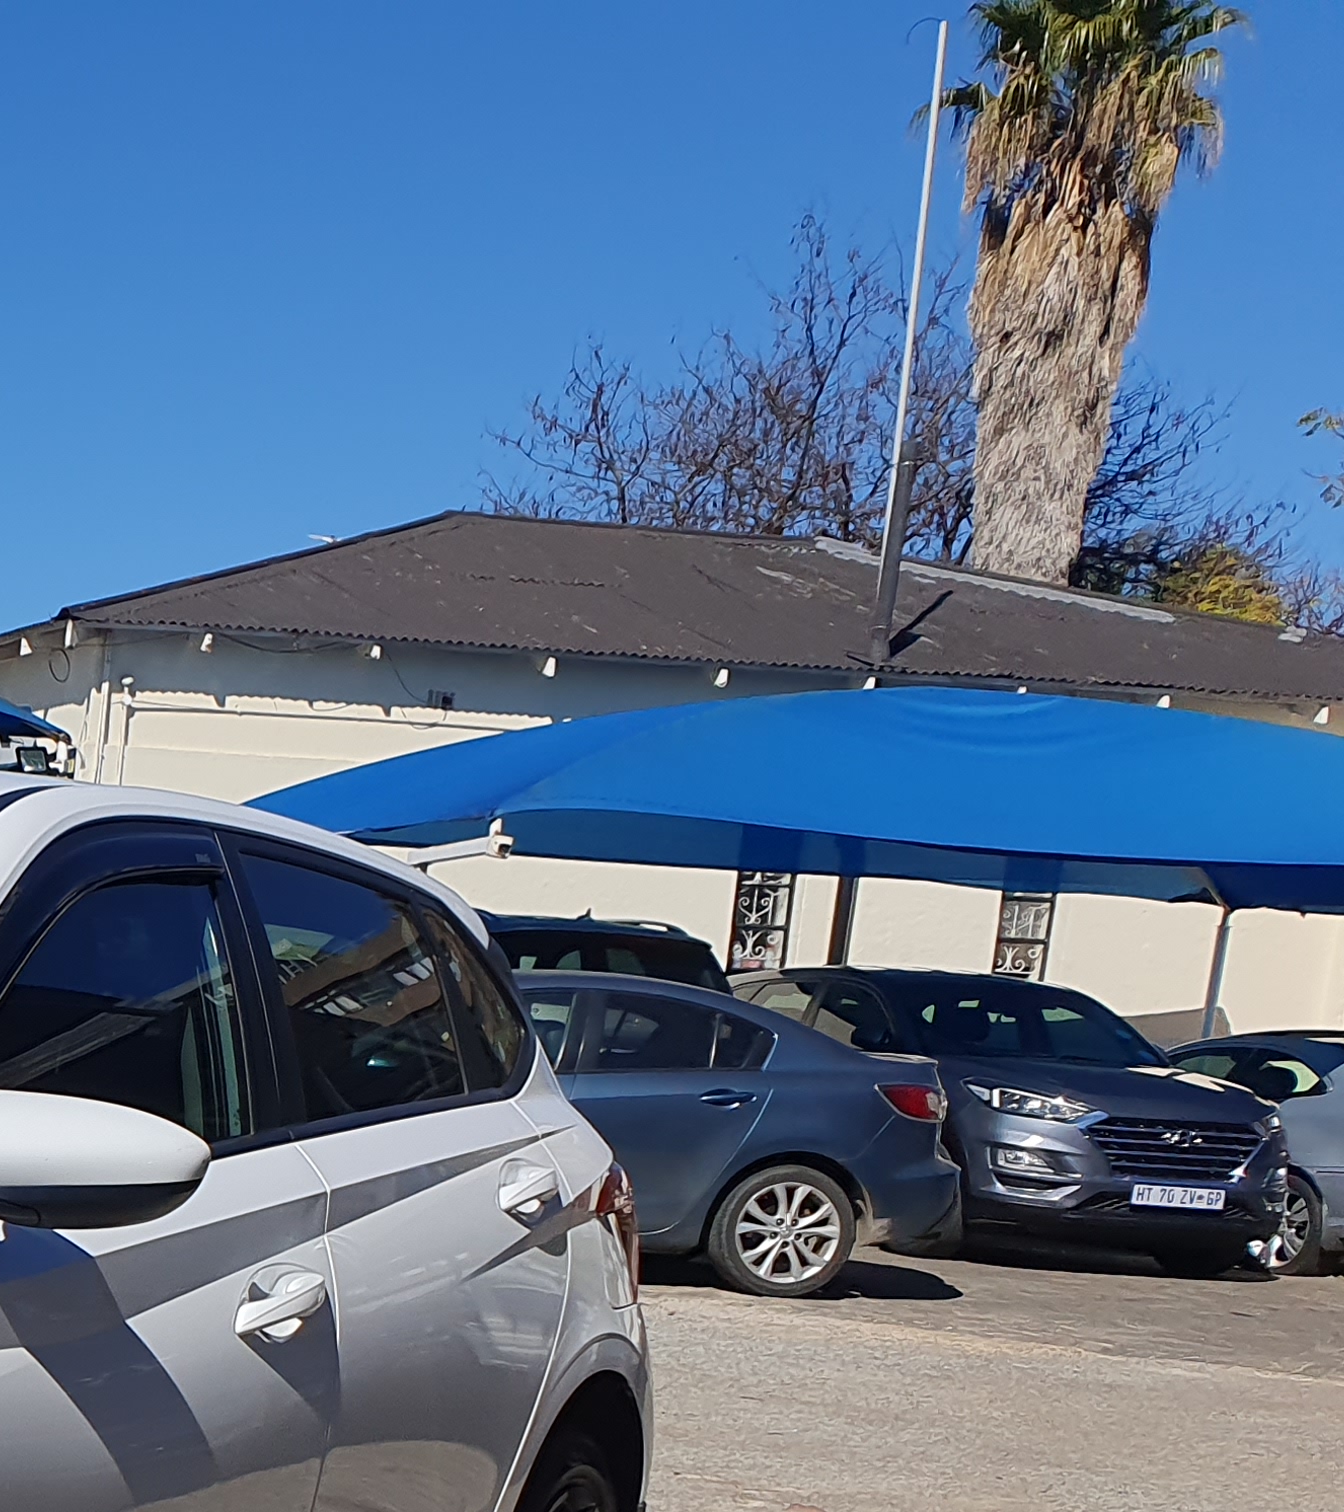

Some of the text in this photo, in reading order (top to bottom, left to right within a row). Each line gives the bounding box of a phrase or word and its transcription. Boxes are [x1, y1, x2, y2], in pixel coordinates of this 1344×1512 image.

[1135, 1187, 1222, 1206] HT 70 ZV GP
